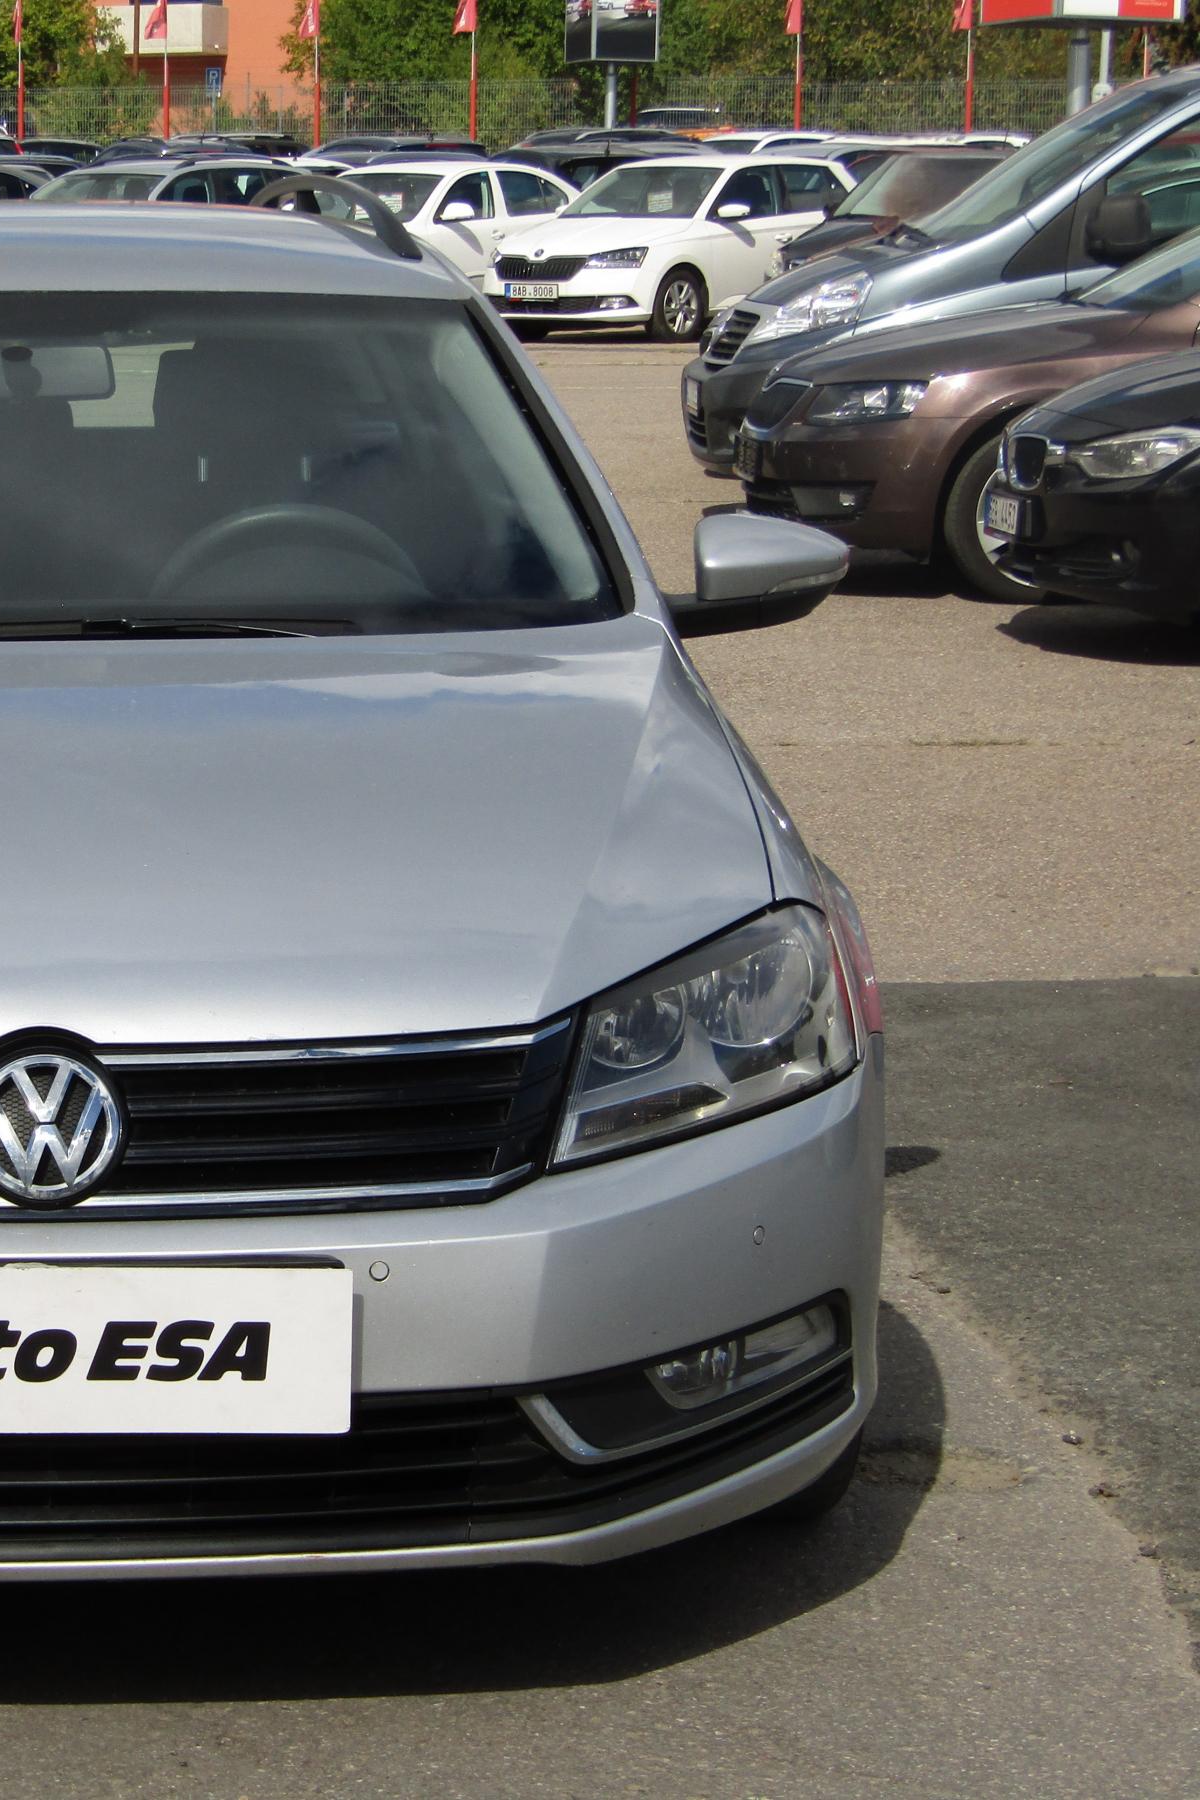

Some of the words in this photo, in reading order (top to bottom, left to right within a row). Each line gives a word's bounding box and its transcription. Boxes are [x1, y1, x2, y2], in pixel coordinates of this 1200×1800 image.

[512, 286, 527, 297] 8AB
[533, 286, 554, 297] 8008
[86, 1319, 272, 1382] ESA
